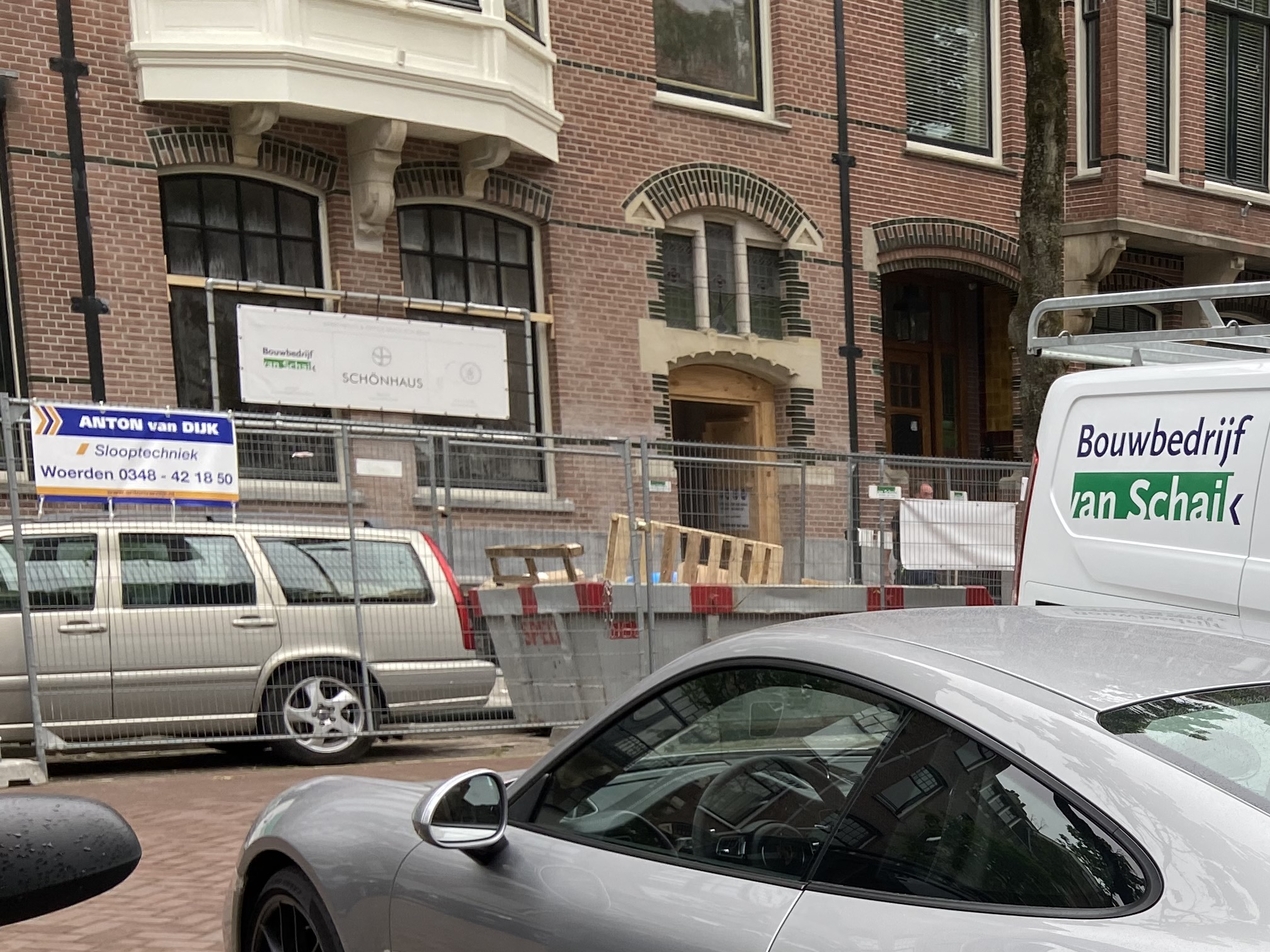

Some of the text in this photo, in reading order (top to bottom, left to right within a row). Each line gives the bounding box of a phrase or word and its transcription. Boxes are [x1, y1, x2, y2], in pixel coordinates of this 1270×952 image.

[342, 372, 423, 389] SCHÖNHAUS
[79, 415, 219, 436] ANTON van DIJK
[1077, 414, 1254, 467] Bouwbedrijf
[95, 443, 198, 461] Slooptechniek
[40, 464, 114, 480] Woerden
[118, 468, 157, 482] 0348
[171, 470, 190, 483] 42
[194, 472, 213, 484] 18
[217, 473, 233, 485] 50
[1126, 475, 1244, 525] Schaik
